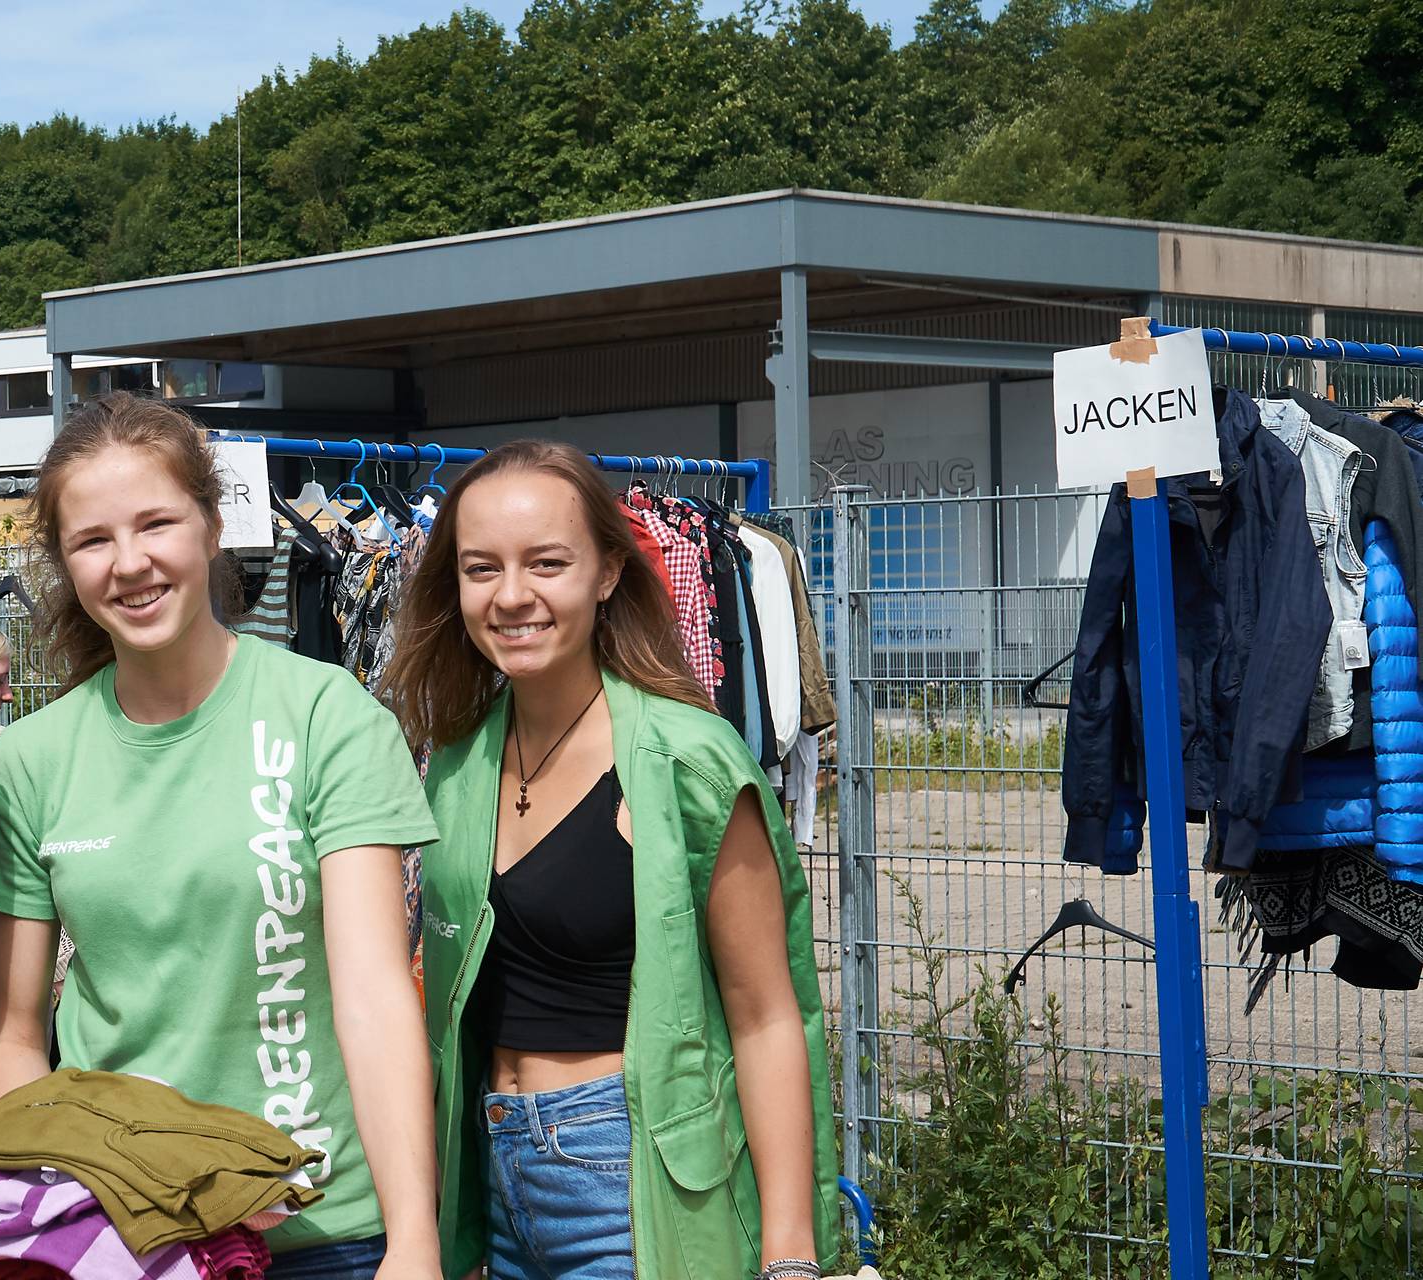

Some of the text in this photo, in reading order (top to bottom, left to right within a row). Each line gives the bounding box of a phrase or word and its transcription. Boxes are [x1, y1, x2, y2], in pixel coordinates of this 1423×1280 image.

[1064, 385, 1197, 435] JACKEN
[38, 835, 117, 859] REENPEACE
[249, 720, 332, 1183] GREENPEACE
